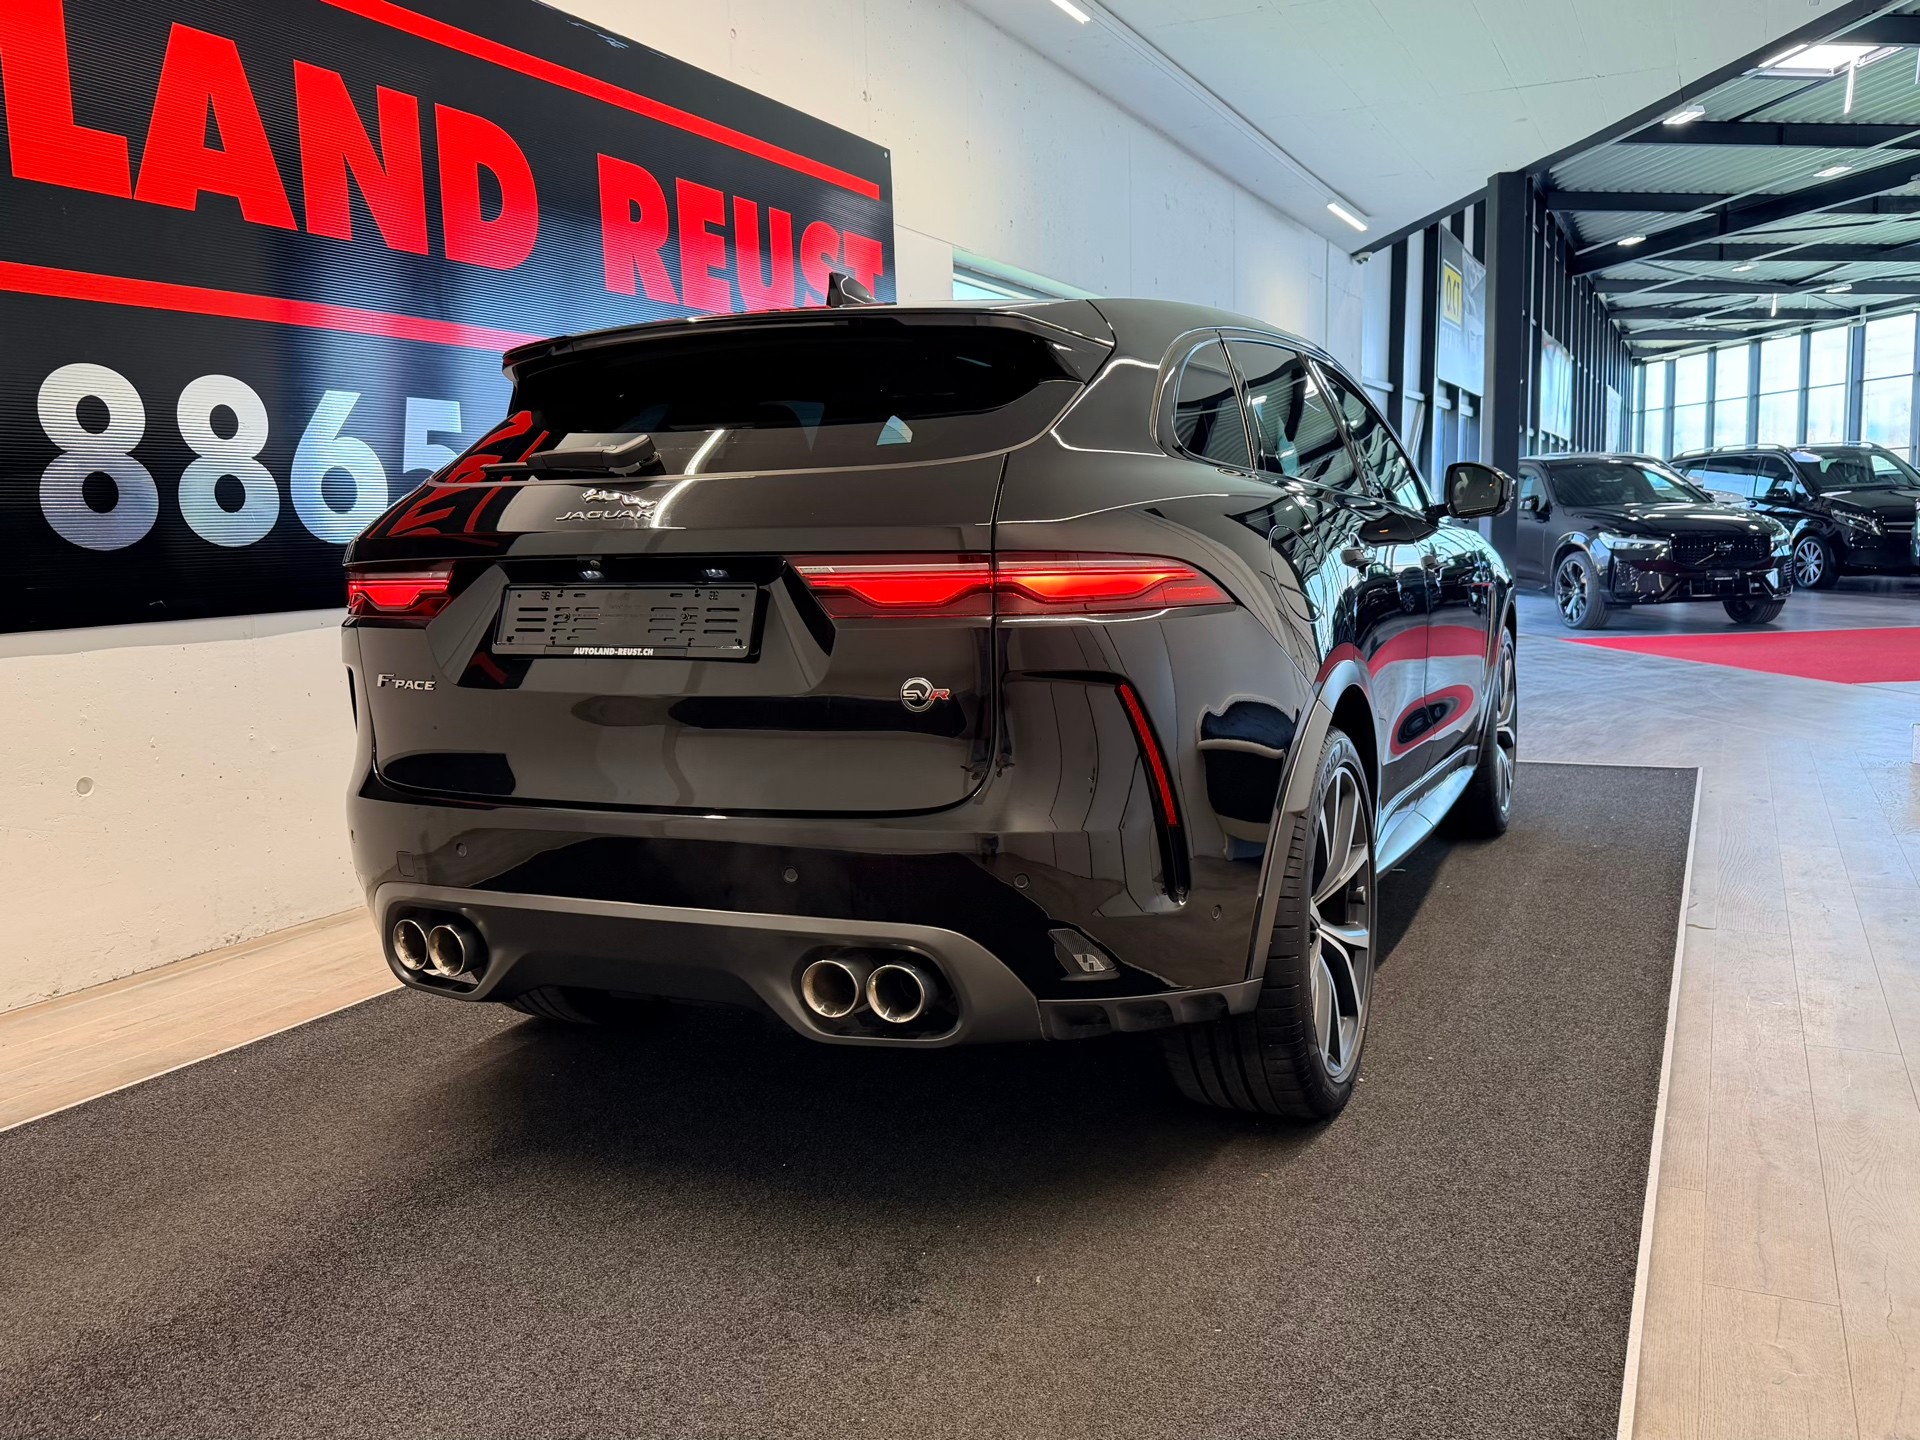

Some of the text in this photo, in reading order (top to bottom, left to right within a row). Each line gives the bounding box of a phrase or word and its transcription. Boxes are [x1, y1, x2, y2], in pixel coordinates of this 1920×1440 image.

[0, 0, 883, 313] LAND REUST
[556, 510, 654, 521] JAGUAR
[573, 647, 654, 656] AUTOLAND-REUST.CH
[377, 674, 436, 690] F-PACE
[902, 680, 950, 701] SVR
